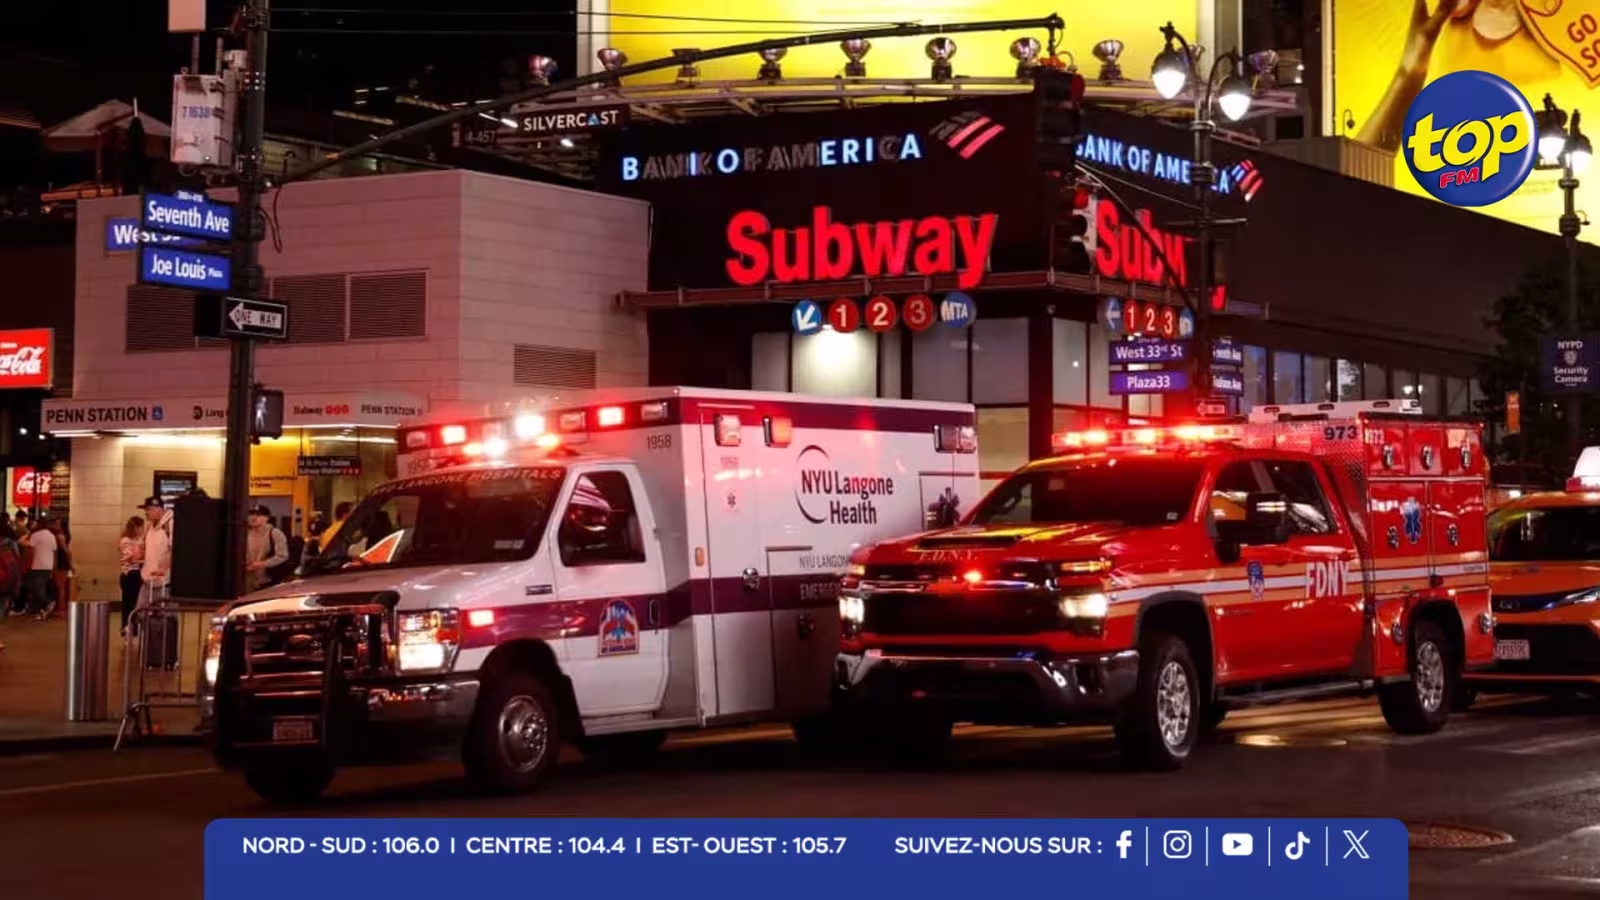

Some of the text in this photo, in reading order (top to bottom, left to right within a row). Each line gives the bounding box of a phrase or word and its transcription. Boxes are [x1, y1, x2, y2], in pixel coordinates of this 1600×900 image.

[1568, 14, 1597, 43] GO
[523, 110, 618, 130] SILVERCAST
[717, 147, 764, 174] OF
[766, 132, 921, 172] AMERICA
[1128, 146, 1151, 174] OF
[1155, 153, 1229, 193] AMEA
[148, 200, 229, 233] Seventh Ave
[725, 206, 998, 290] Subway
[151, 254, 173, 276] Joe
[175, 257, 206, 280] Louis
[235, 309, 277, 326] ONE WAY
[836, 299, 969, 328] 1 2 3 MTA
[1128, 304, 1135, 329] 1
[1146, 308, 1156, 331] 2
[1164, 311, 1173, 334] 3
[1116, 346, 1146, 359] West
[1171, 344, 1182, 357] St
[1557, 340, 1583, 350] NYPD
[1554, 367, 1589, 375] Security
[1554, 375, 1588, 384] Camera
[1127, 375, 1171, 389] Plaza33
[47, 406, 147, 424] PENN STATION
[293, 405, 323, 416] Subway
[361, 404, 382, 414] PENN
[384, 405, 416, 416] STATION
[647, 433, 672, 450] 1958
[1324, 425, 1357, 441] 973
[468, 467, 561, 481] HOSPITALS
[802, 469, 893, 501] NYU Langone
[830, 500, 877, 525] Health
[800, 554, 850, 569] NYU LANGON
[1306, 560, 1349, 599] FDNY
